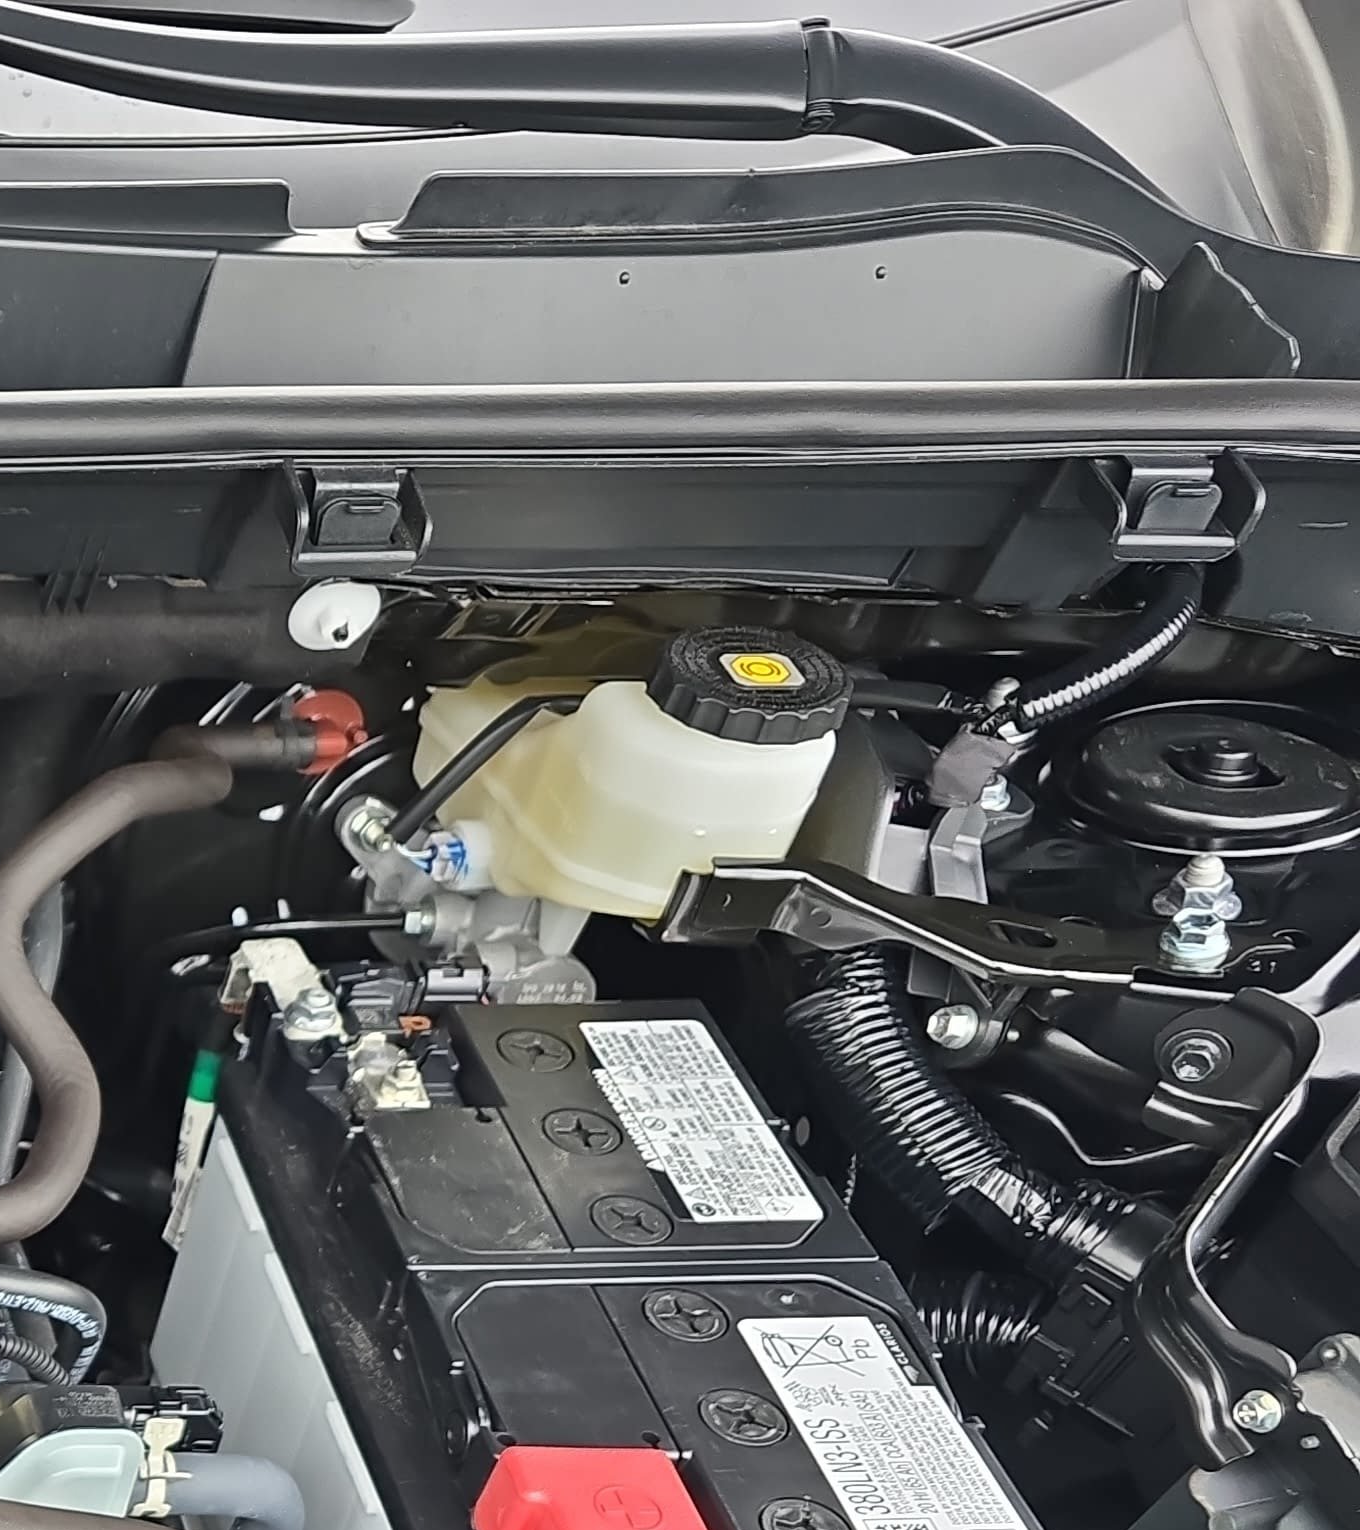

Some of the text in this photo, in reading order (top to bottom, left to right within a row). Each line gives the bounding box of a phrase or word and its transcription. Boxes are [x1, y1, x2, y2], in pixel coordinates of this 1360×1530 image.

[852, 1339, 880, 1359] Pb
[875, 1322, 910, 1364] CLARIOS
[845, 1390, 879, 1411] (SAE)
[876, 1440, 906, 1458] CCA
[800, 1418, 893, 1515] 380LN3-ISS
[891, 1463, 917, 1475] Ah
[899, 1477, 924, 1487] 65
[907, 1490, 933, 1500] Hr
[915, 1502, 940, 1513] 20
